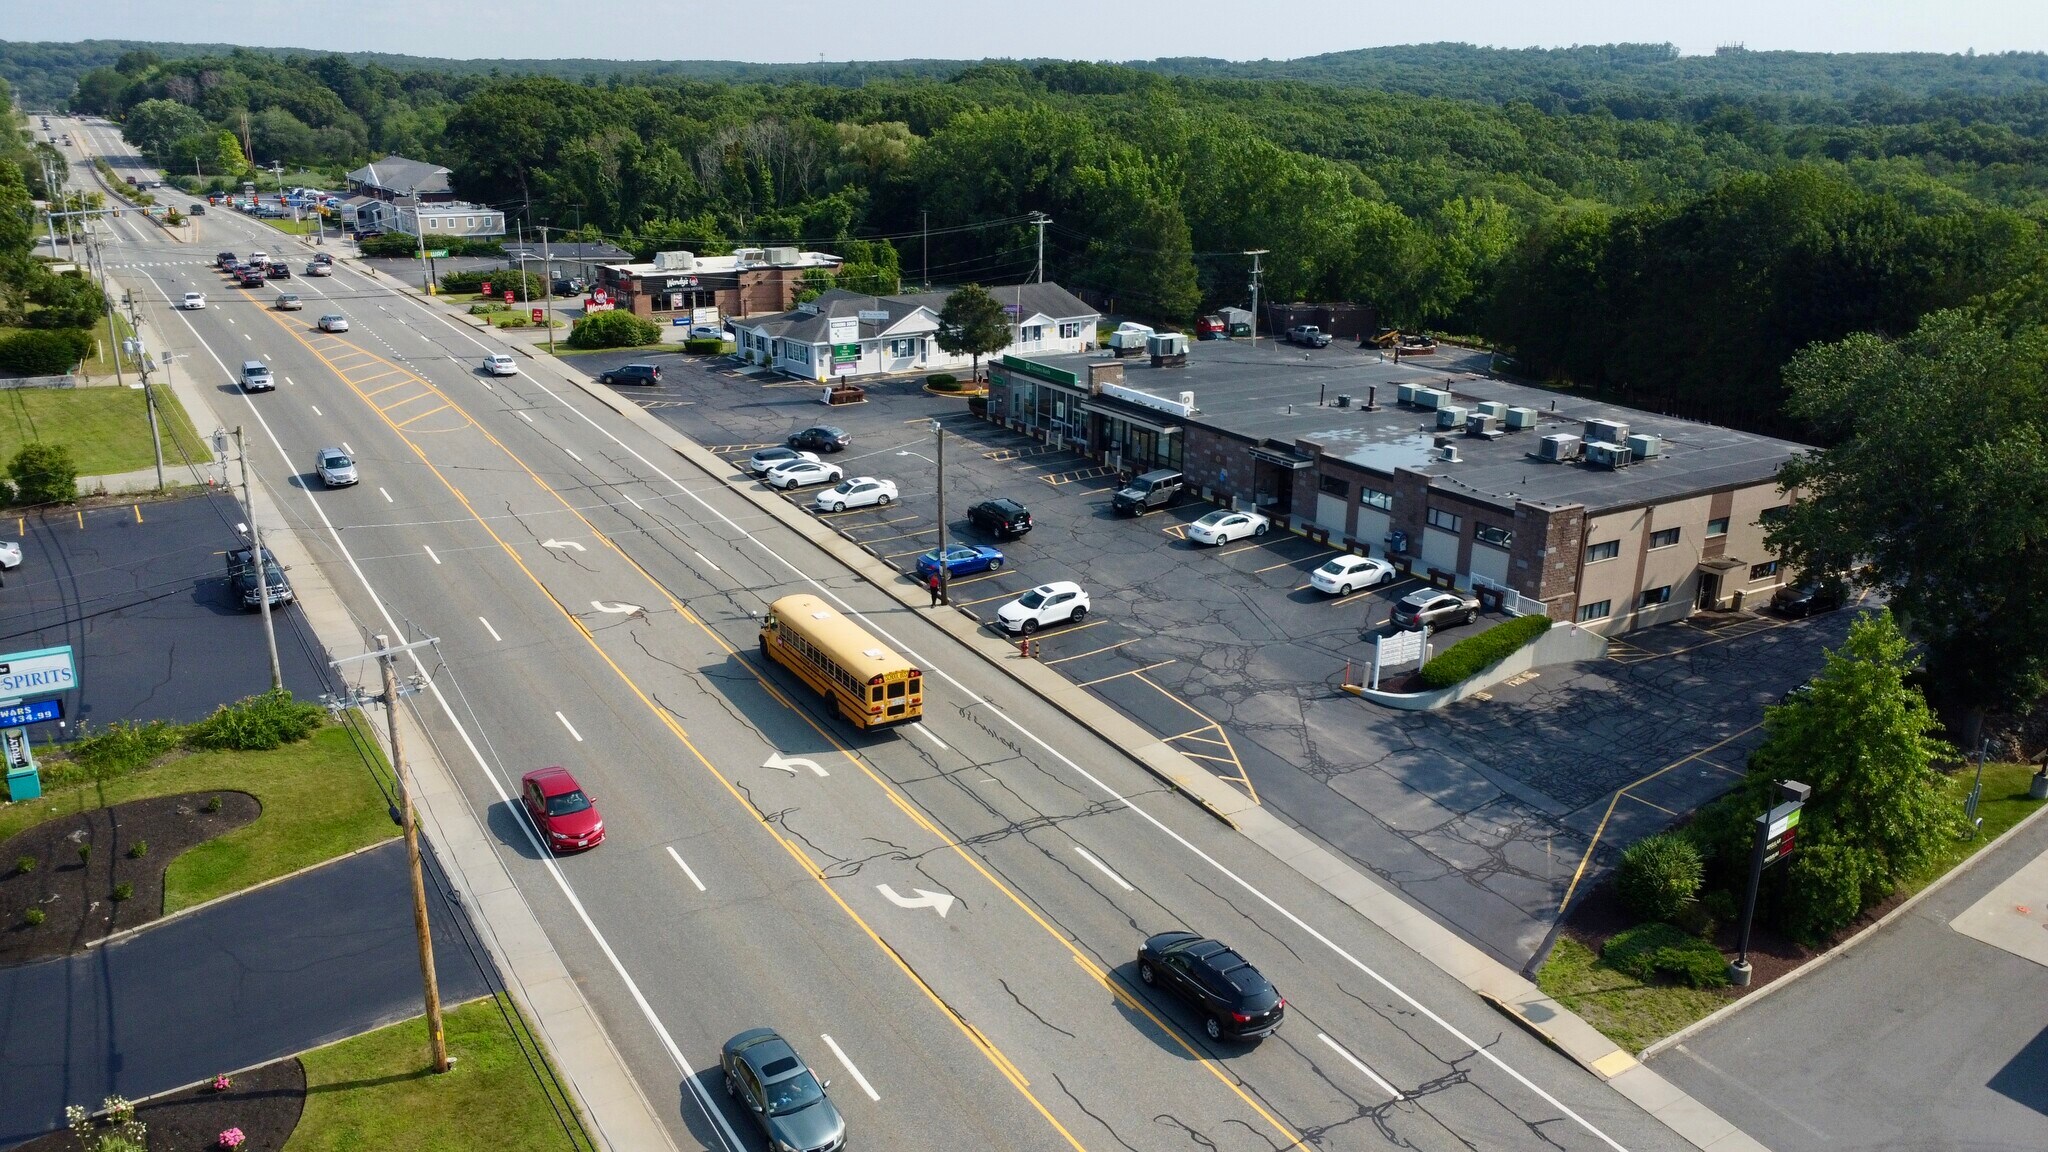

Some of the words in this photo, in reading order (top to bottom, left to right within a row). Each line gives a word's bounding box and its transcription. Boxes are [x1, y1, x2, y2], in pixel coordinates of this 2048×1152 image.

[666, 277, 688, 288] Wendy's
[3, 668, 71, 690] SPIRITS
[0, 706, 32, 718] WARS
[12, 710, 52, 723] $34.99
[9, 738, 21, 767] TRULY
